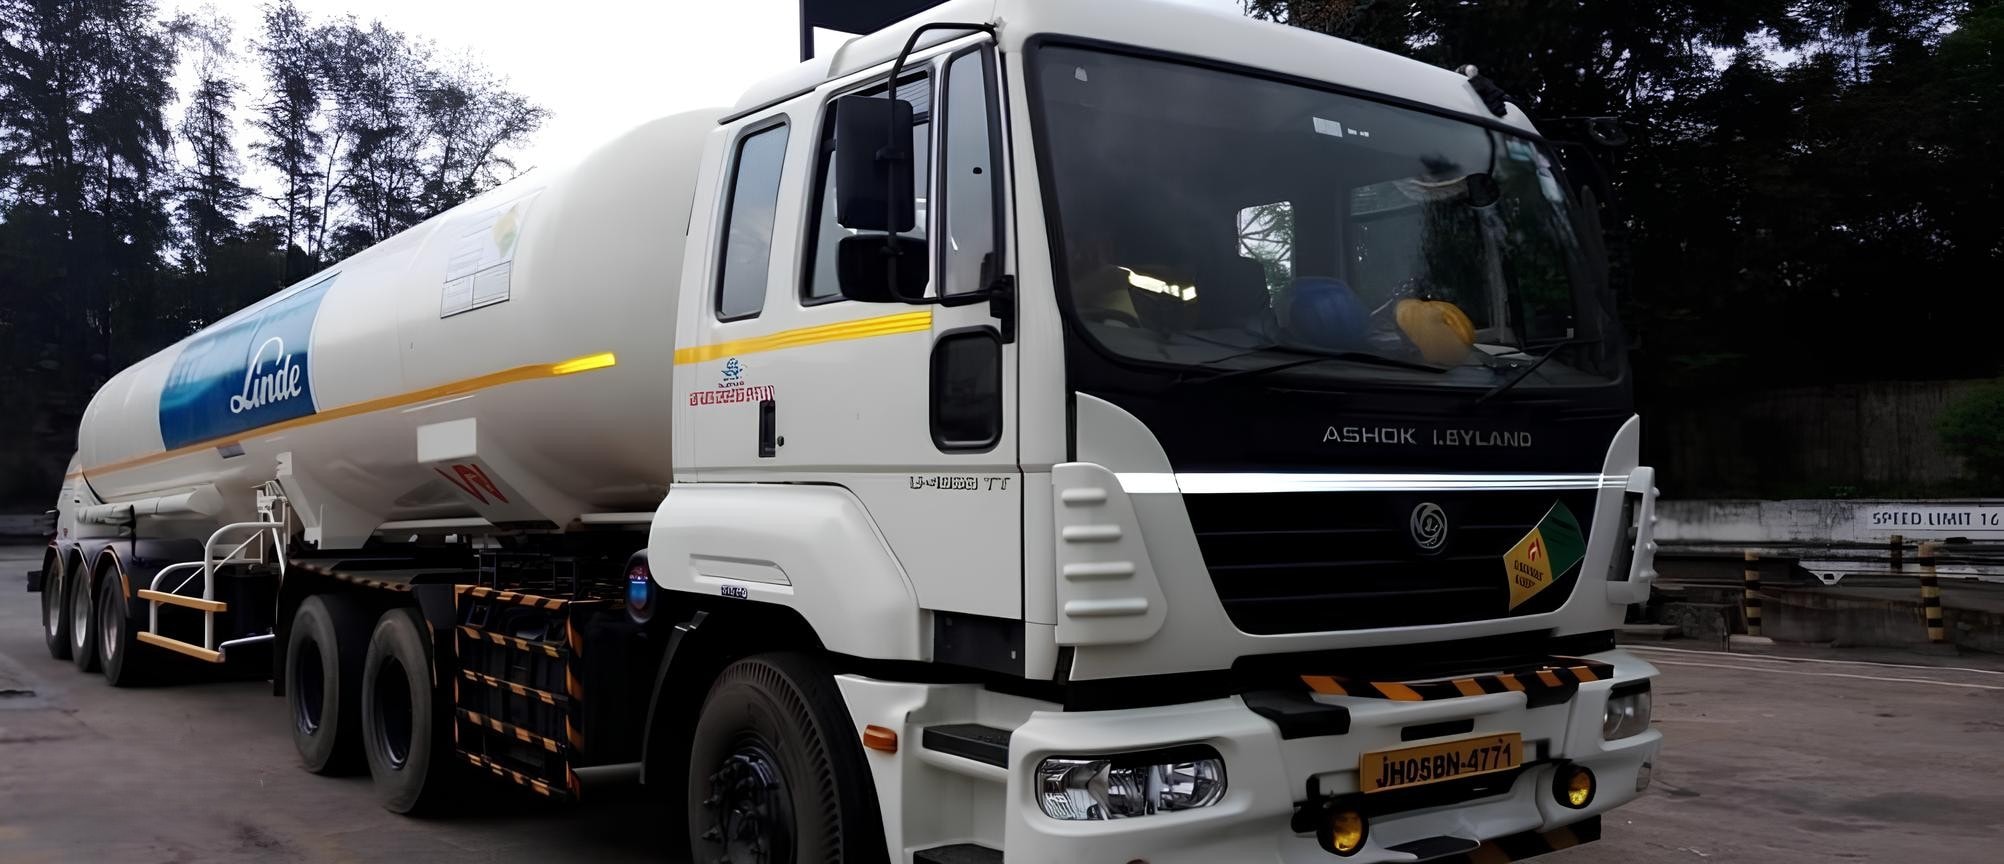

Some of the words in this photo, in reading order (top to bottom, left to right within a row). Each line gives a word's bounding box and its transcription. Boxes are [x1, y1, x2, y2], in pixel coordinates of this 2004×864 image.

[230, 336, 302, 413] Linde
[1322, 426, 1417, 445] ASHOK
[1928, 512, 1971, 526] LIMIT
